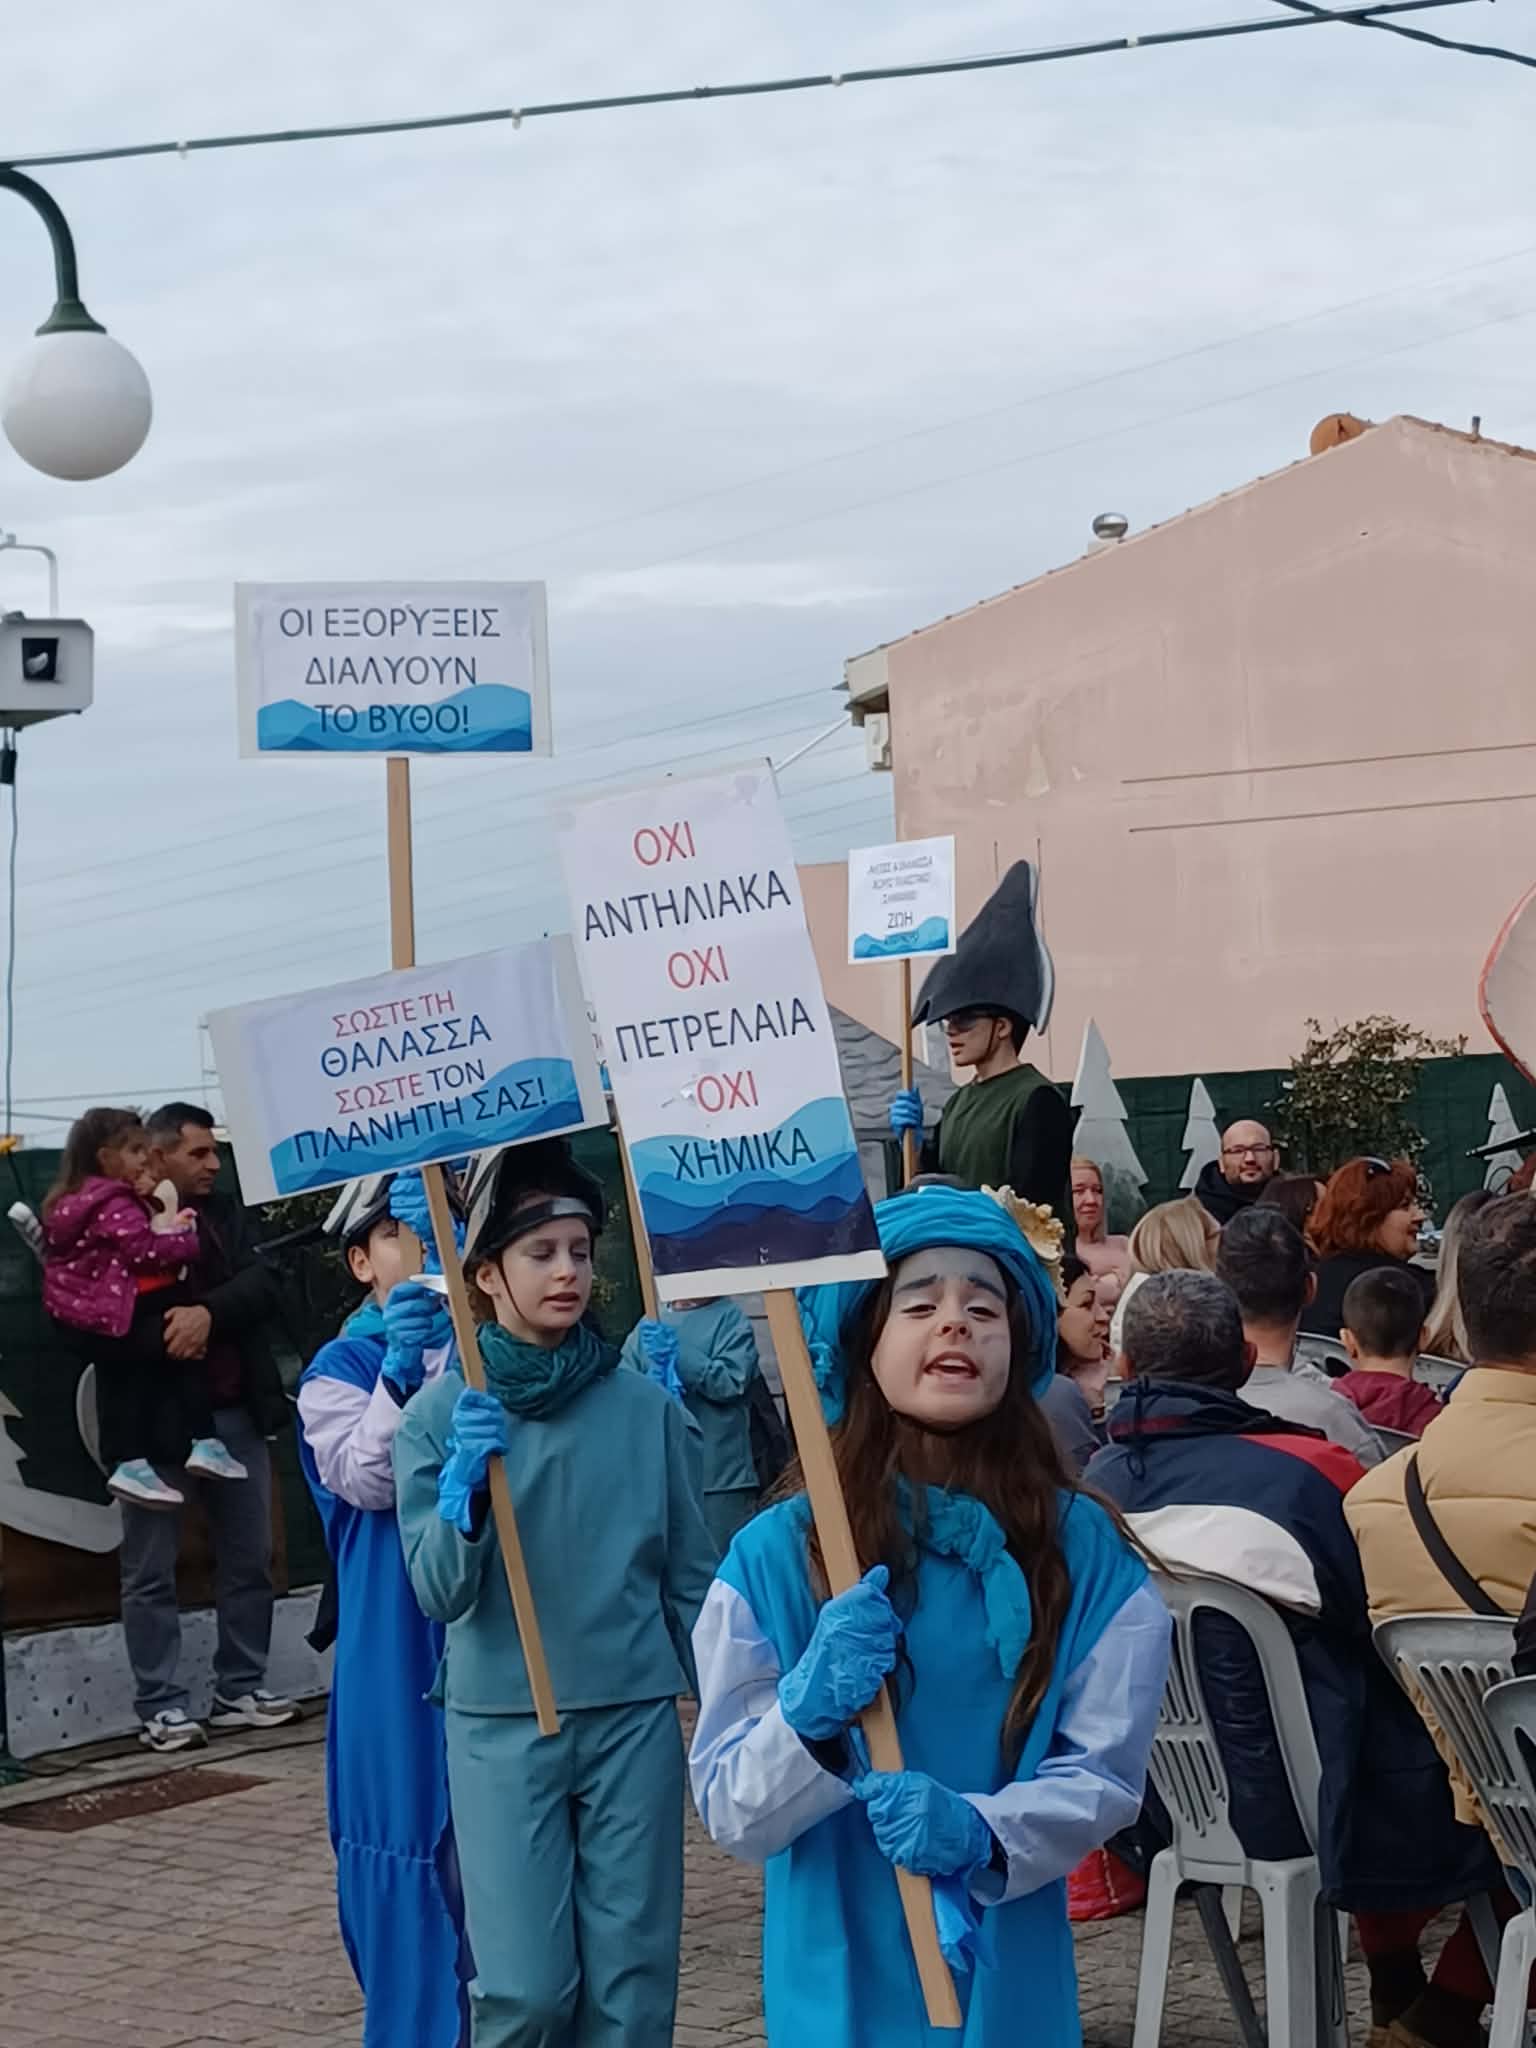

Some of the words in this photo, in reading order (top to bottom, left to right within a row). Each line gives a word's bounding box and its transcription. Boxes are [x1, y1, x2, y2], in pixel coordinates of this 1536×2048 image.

[279, 608, 312, 637] ΟΙ
[305, 656, 477, 685] ΔΙΑΛΥΟΥΝ
[314, 704, 358, 734] ΤΟ
[368, 704, 469, 734] ΒΥΘΟ!
[633, 820, 696, 866] ΟΧΙ
[584, 870, 792, 941] ΑΝΤΗΛΙΑΚΑ
[667, 945, 729, 990] ΟΧΙ
[332, 998, 418, 1038] ΣΩΣΤΕ
[419, 990, 456, 1018] ΤΗ
[615, 998, 816, 1063] ΠΕΤΡΕΛΑΙΑ
[321, 1014, 492, 1077] ΘΑΛΑΣΣΑ
[336, 1072, 425, 1115] ΣΩΣΤΕ
[427, 1058, 486, 1092] ΤΟΝ
[696, 1070, 759, 1114] ΟΧΙ
[293, 1096, 465, 1163] ΠΛΑΝΗΤΗ
[474, 1076, 548, 1121] ΣΑΣ!
[668, 1127, 817, 1181] ΧΗΜΙΚΑ
